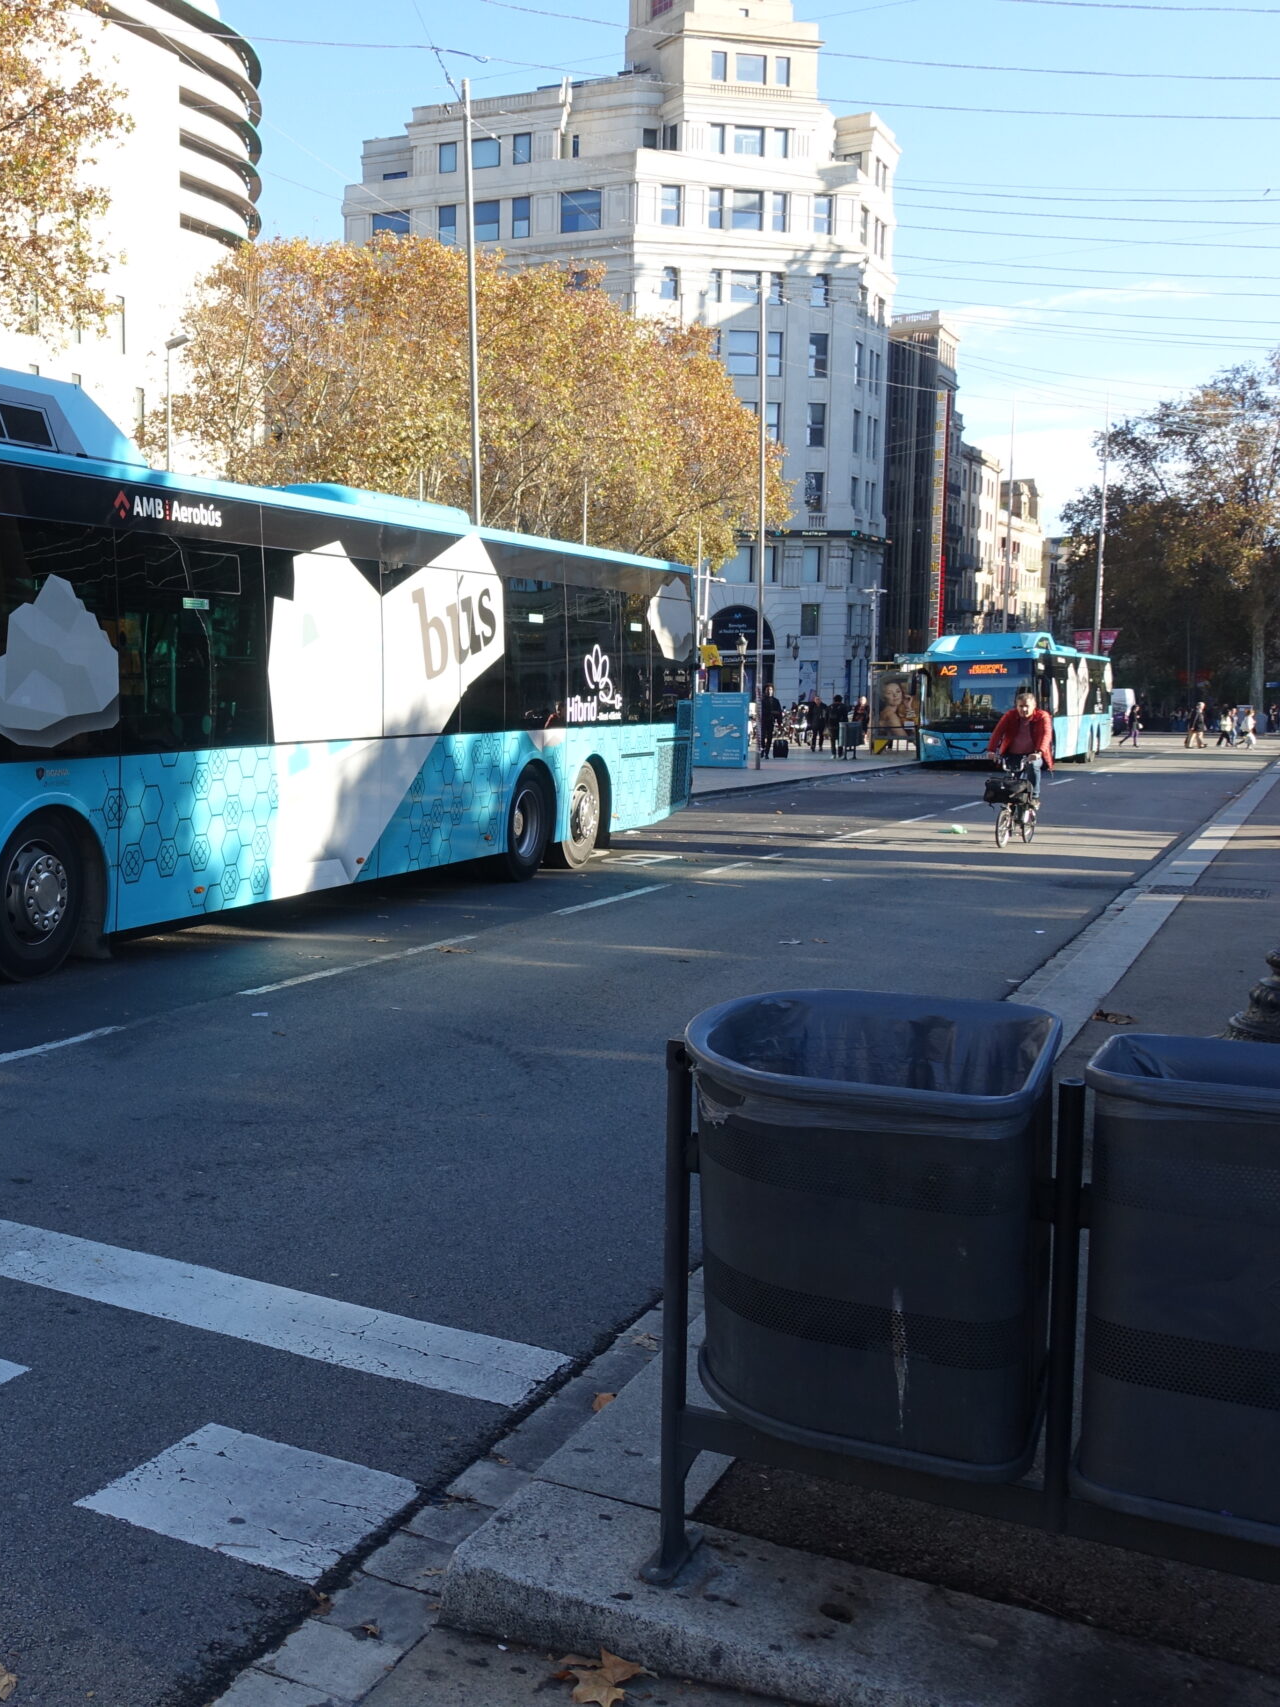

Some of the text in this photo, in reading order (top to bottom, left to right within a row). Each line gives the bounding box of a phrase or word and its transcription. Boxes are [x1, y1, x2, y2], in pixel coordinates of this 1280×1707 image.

[133, 495, 223, 528] AMB Aerobús
[940, 665, 957, 676] A2
